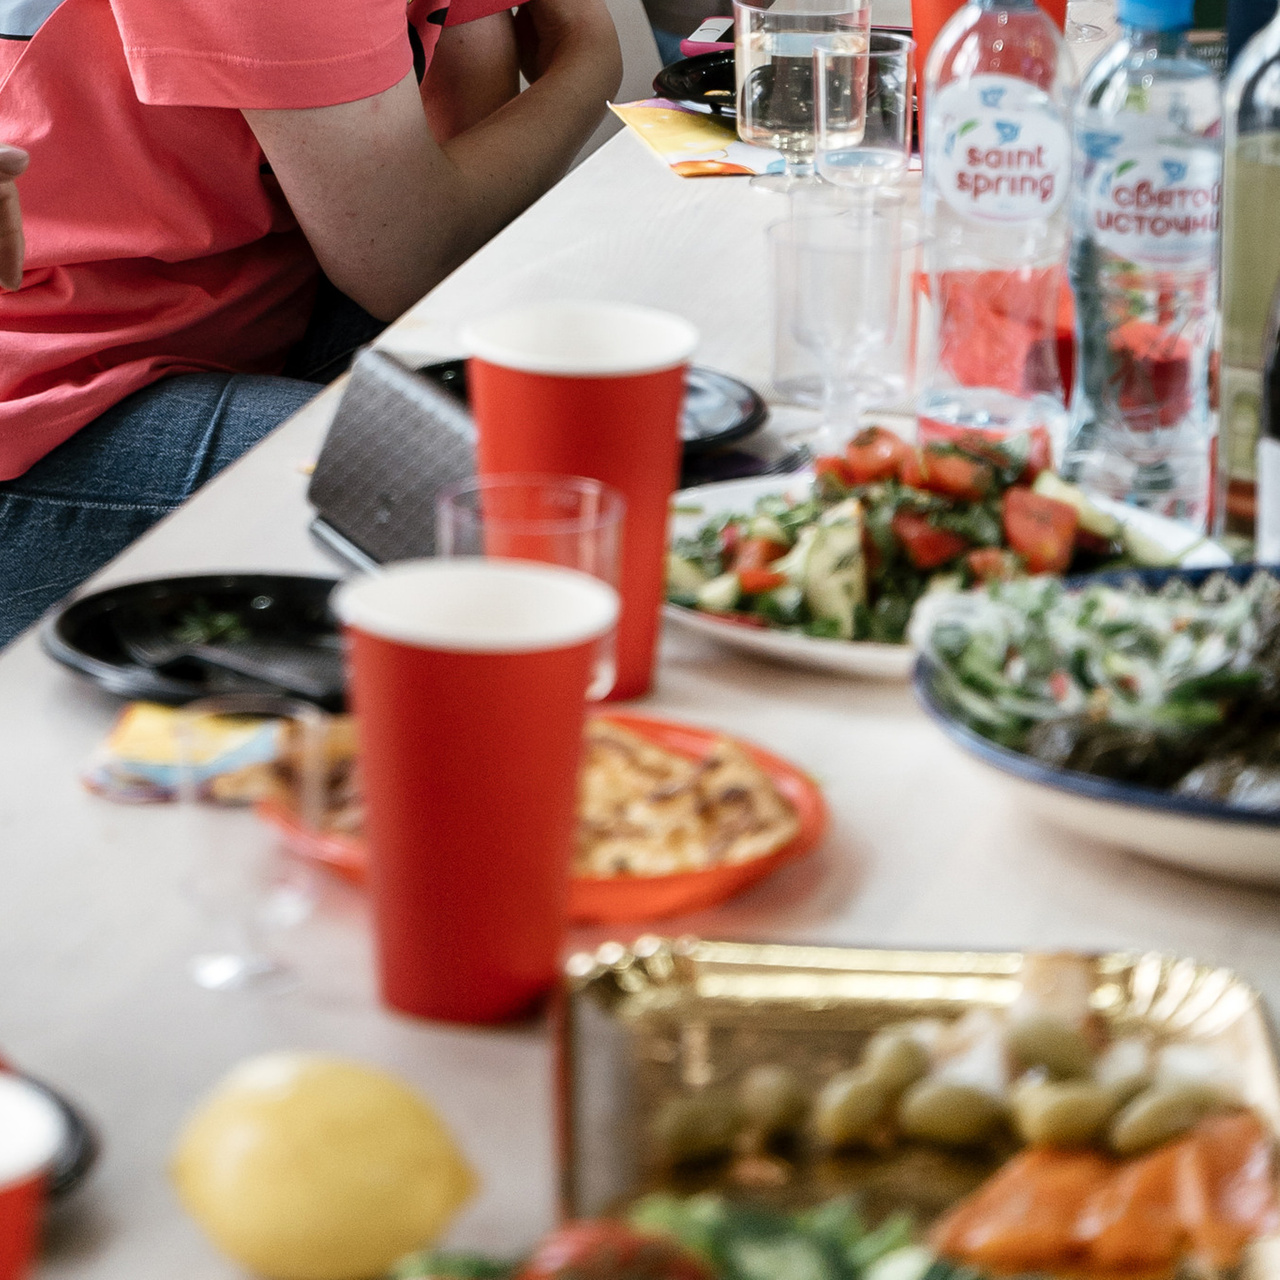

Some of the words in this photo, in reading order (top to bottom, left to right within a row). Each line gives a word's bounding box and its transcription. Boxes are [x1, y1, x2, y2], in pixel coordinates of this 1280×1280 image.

[966, 144, 1045, 169] saint
[955, 171, 1056, 204] spring
[1094, 210, 1221, 237] источни
